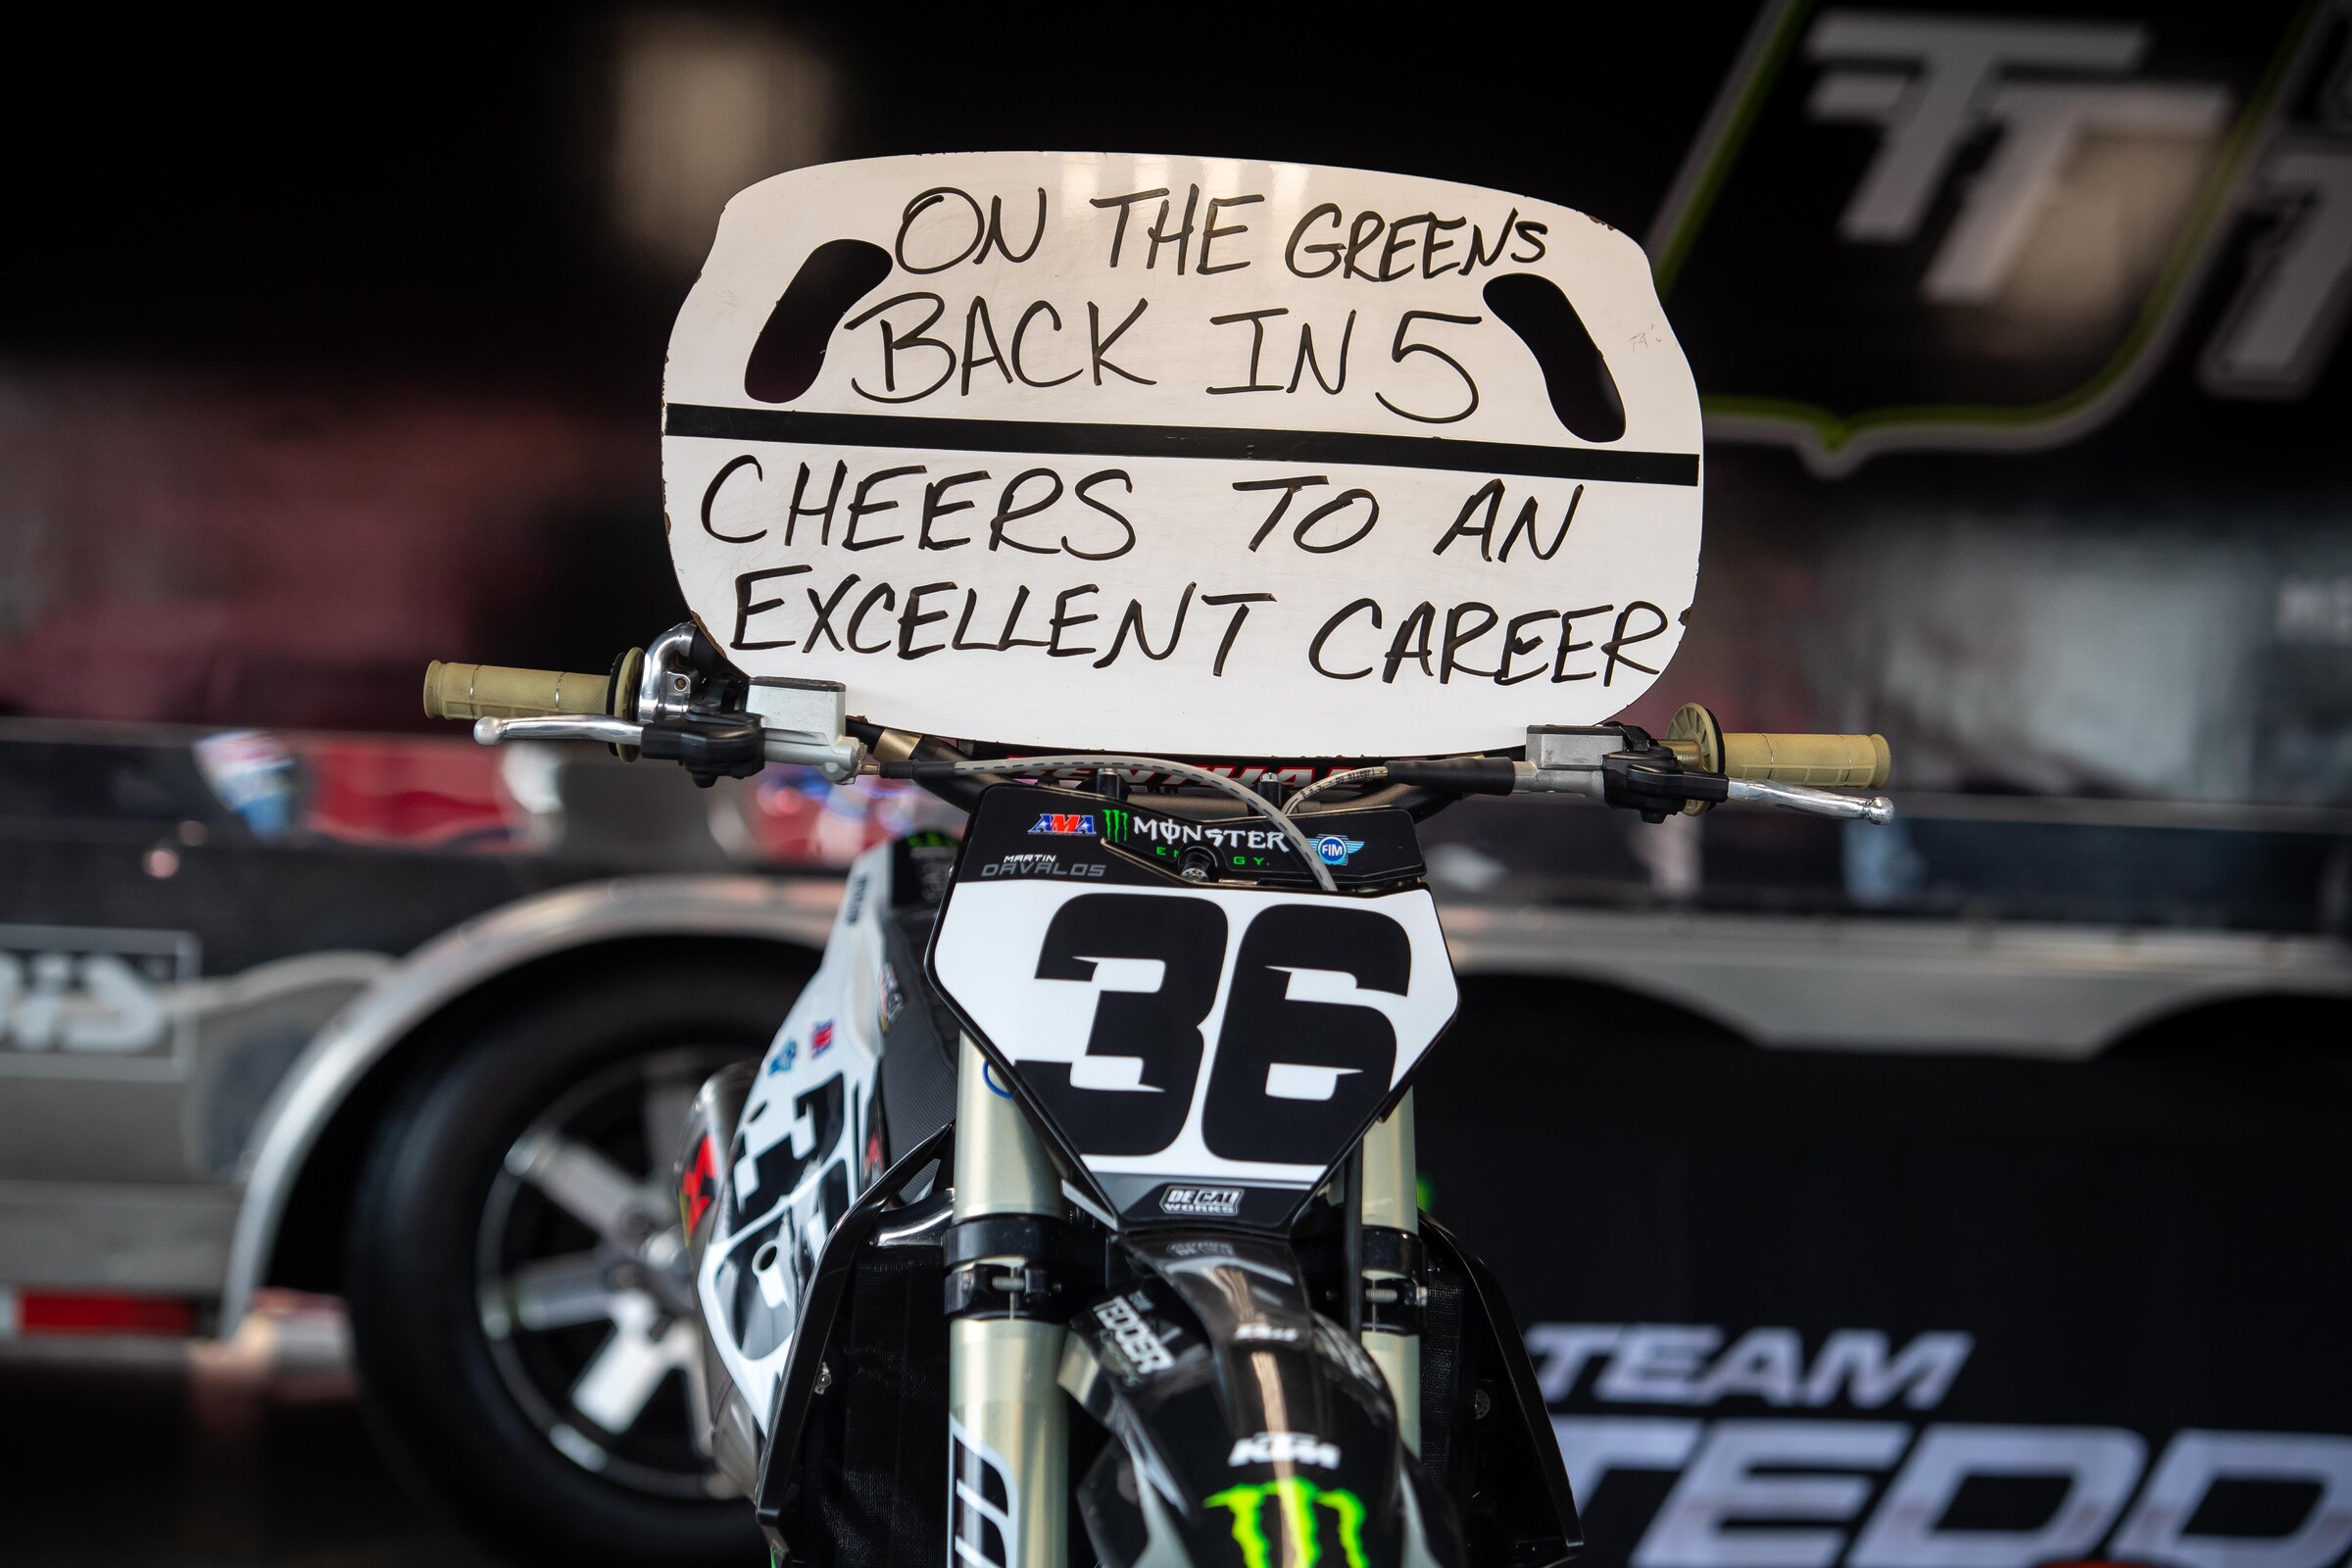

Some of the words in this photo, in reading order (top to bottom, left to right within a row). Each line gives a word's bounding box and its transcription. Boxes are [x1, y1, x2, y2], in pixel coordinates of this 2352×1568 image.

[896, 187, 1047, 274] ON
[1090, 184, 1265, 276] THE
[1285, 202, 1548, 282] GREENS
[844, 292, 1157, 404] BACK
[1206, 308, 1357, 396] IN
[1375, 310, 1483, 424] 5
[701, 454, 1137, 561] CHEERS
[1232, 475, 1380, 554] TO
[1432, 477, 1585, 564] AN
[729, 564, 1277, 677] EXCELLENT
[1308, 598, 1669, 687] CAREER
[1003, 854, 1057, 864] MARTIN
[1028, 813, 1097, 836] AMA
[1133, 815, 1290, 854] MONSTER
[1321, 842, 1344, 856] FIM
[981, 861, 1107, 878] DAVALOS
[1013, 892, 1412, 1166] 36
[1526, 1323, 1974, 1407] TEAM
